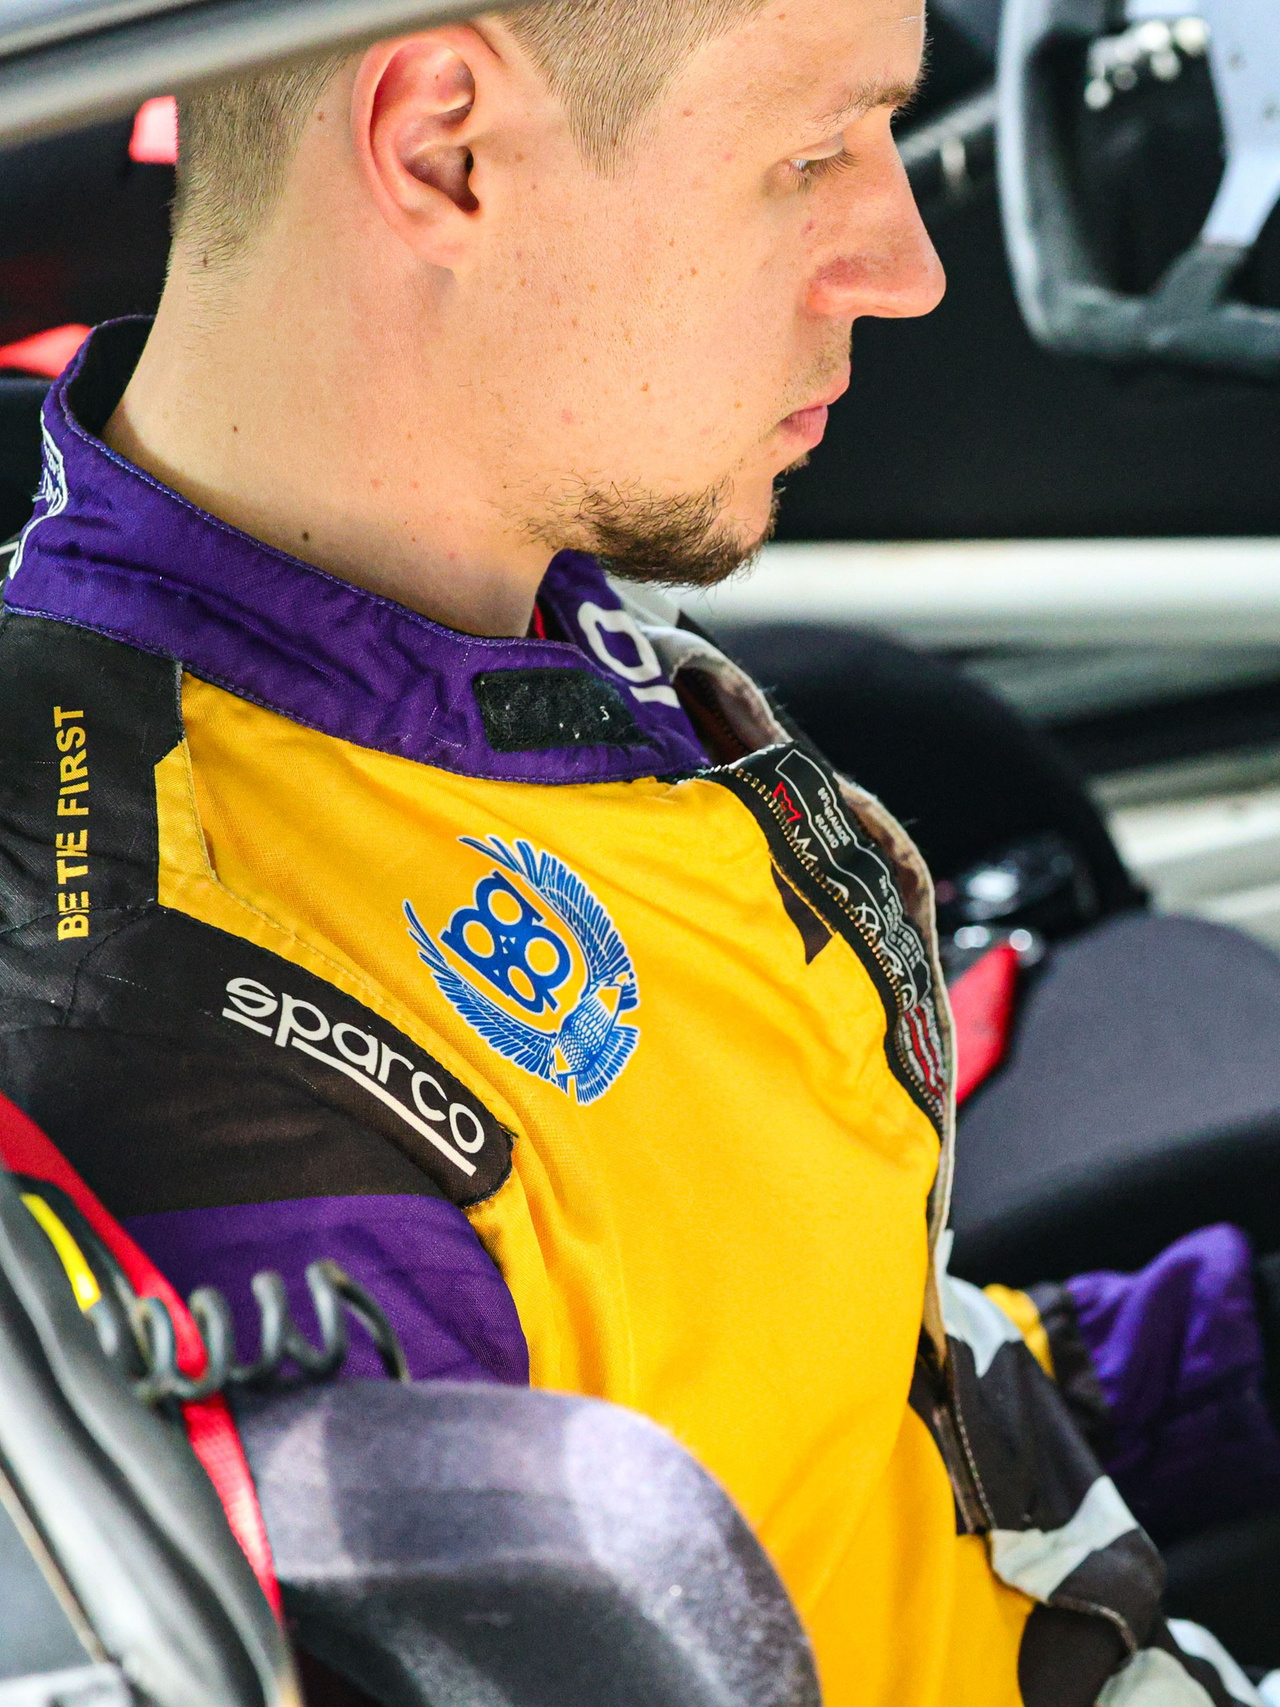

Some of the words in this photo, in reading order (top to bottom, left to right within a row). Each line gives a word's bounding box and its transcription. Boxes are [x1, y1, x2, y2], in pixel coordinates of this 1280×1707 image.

[53, 705, 90, 816] FIRST
[57, 891, 89, 941] BE
[224, 976, 486, 1155] sparco
